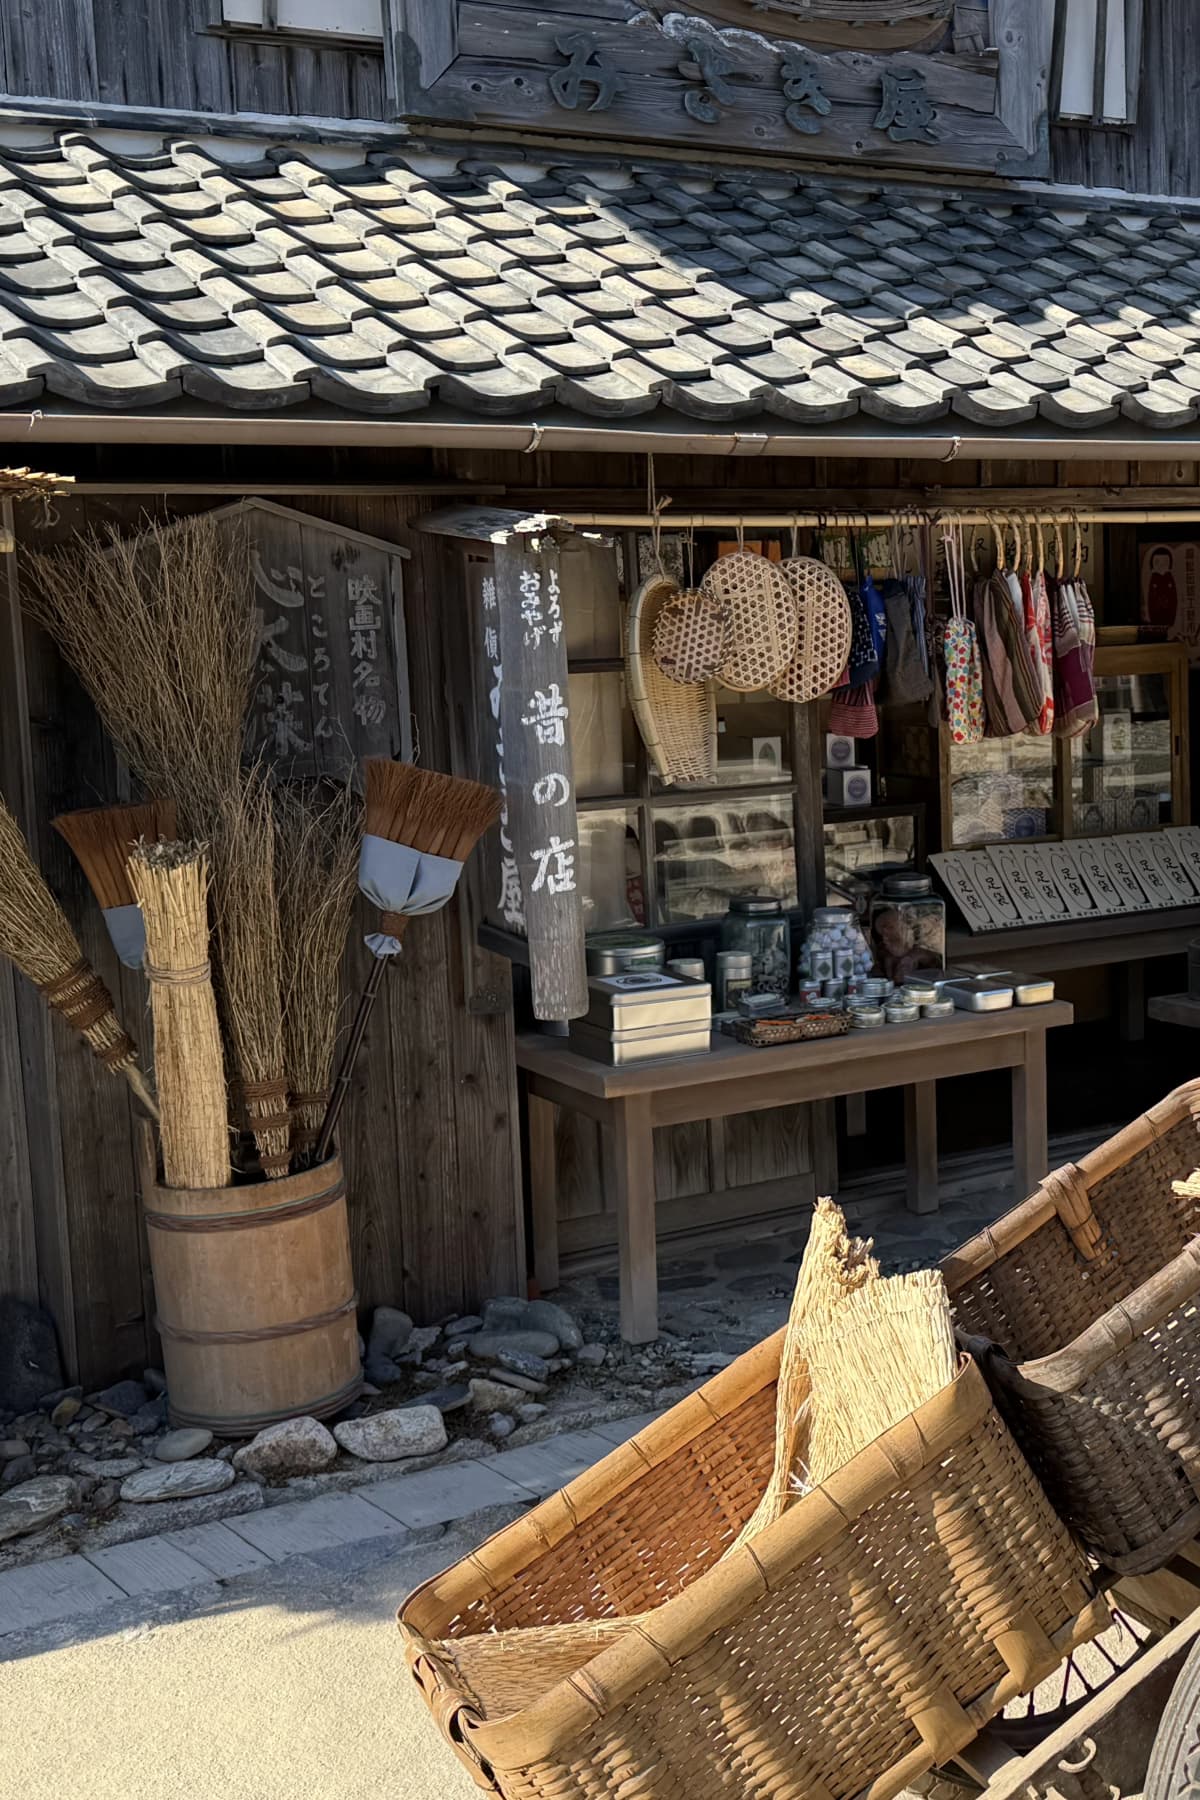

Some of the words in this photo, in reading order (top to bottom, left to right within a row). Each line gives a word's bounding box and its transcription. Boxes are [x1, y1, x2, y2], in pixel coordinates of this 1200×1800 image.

[549, 32, 940, 145] みさき屋
[308, 575, 332, 738] ところてん
[347, 574, 386, 726] 映画村名物
[482, 577, 499, 660] 雑貨
[519, 570, 547, 650] おみやげ
[521, 683, 577, 896] 昔の店
